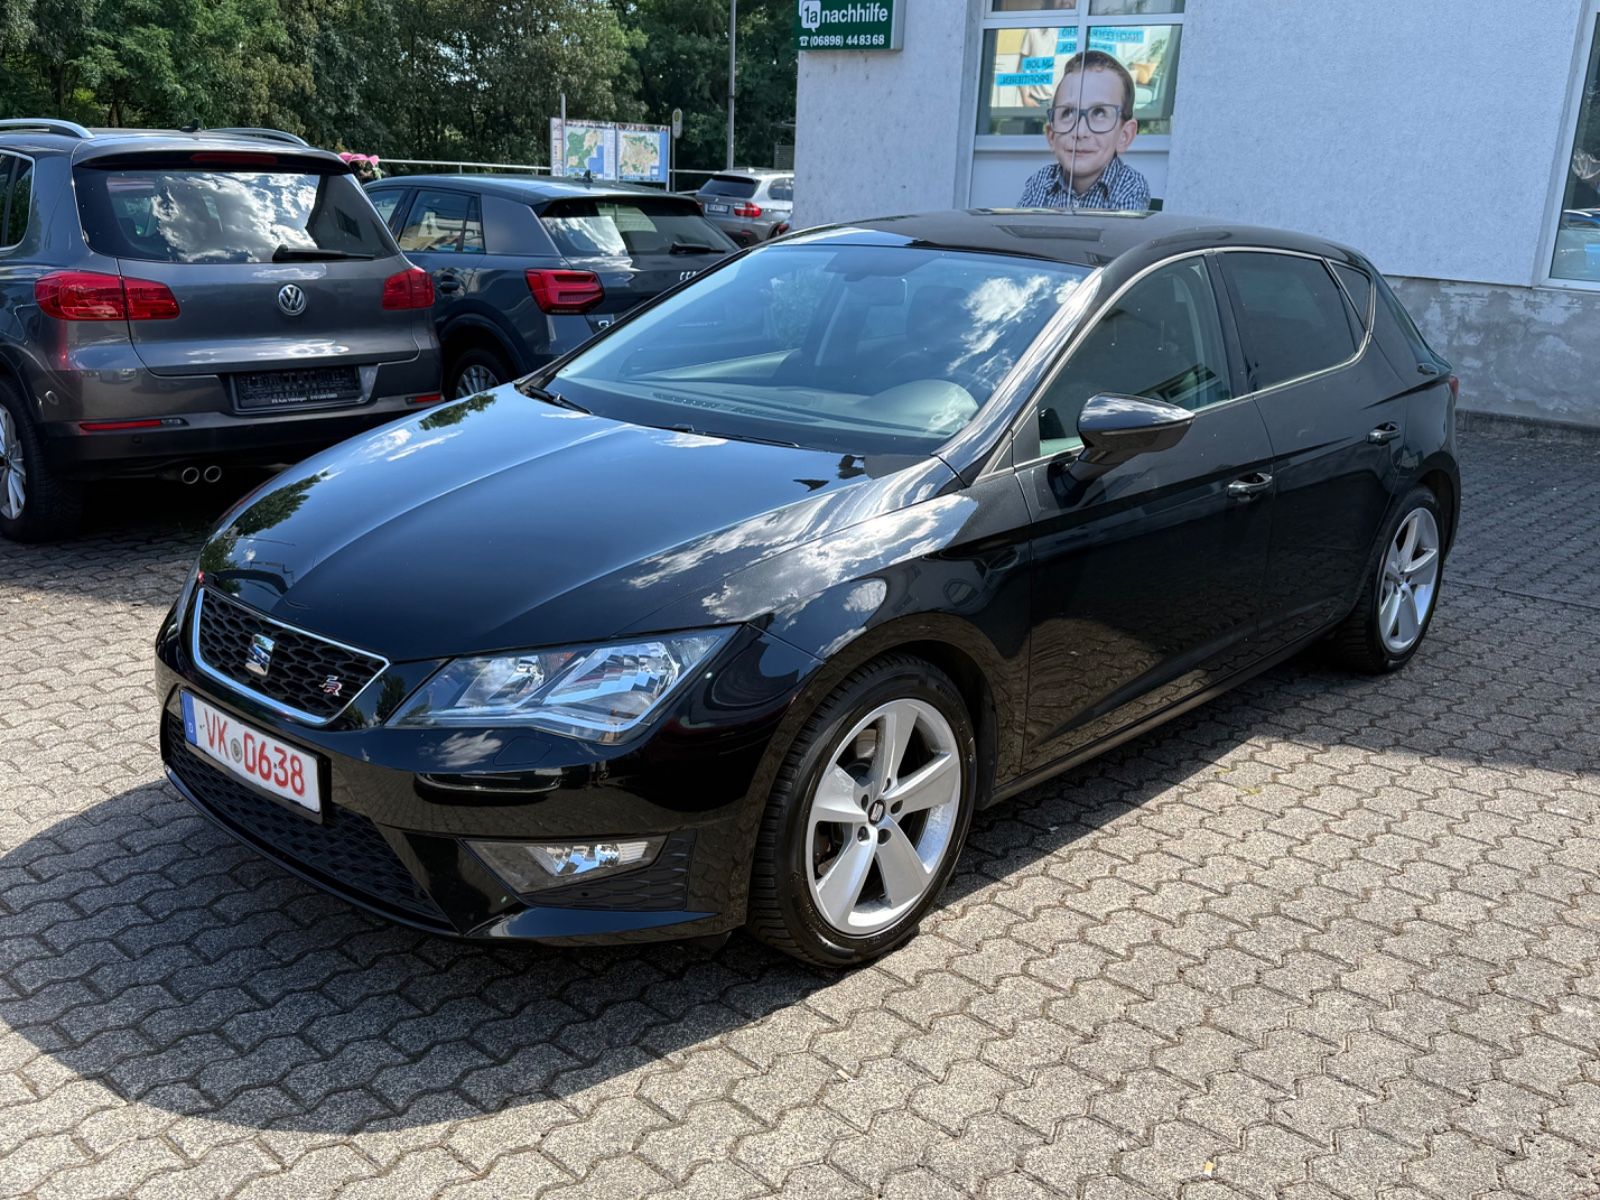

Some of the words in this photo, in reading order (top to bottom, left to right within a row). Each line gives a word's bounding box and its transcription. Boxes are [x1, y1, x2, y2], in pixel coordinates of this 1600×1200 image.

[821, 3, 889, 24] nachhilfe
[810, 35, 844, 47] (06898)
[204, 707, 230, 760] VK
[243, 730, 306, 798] 0638
